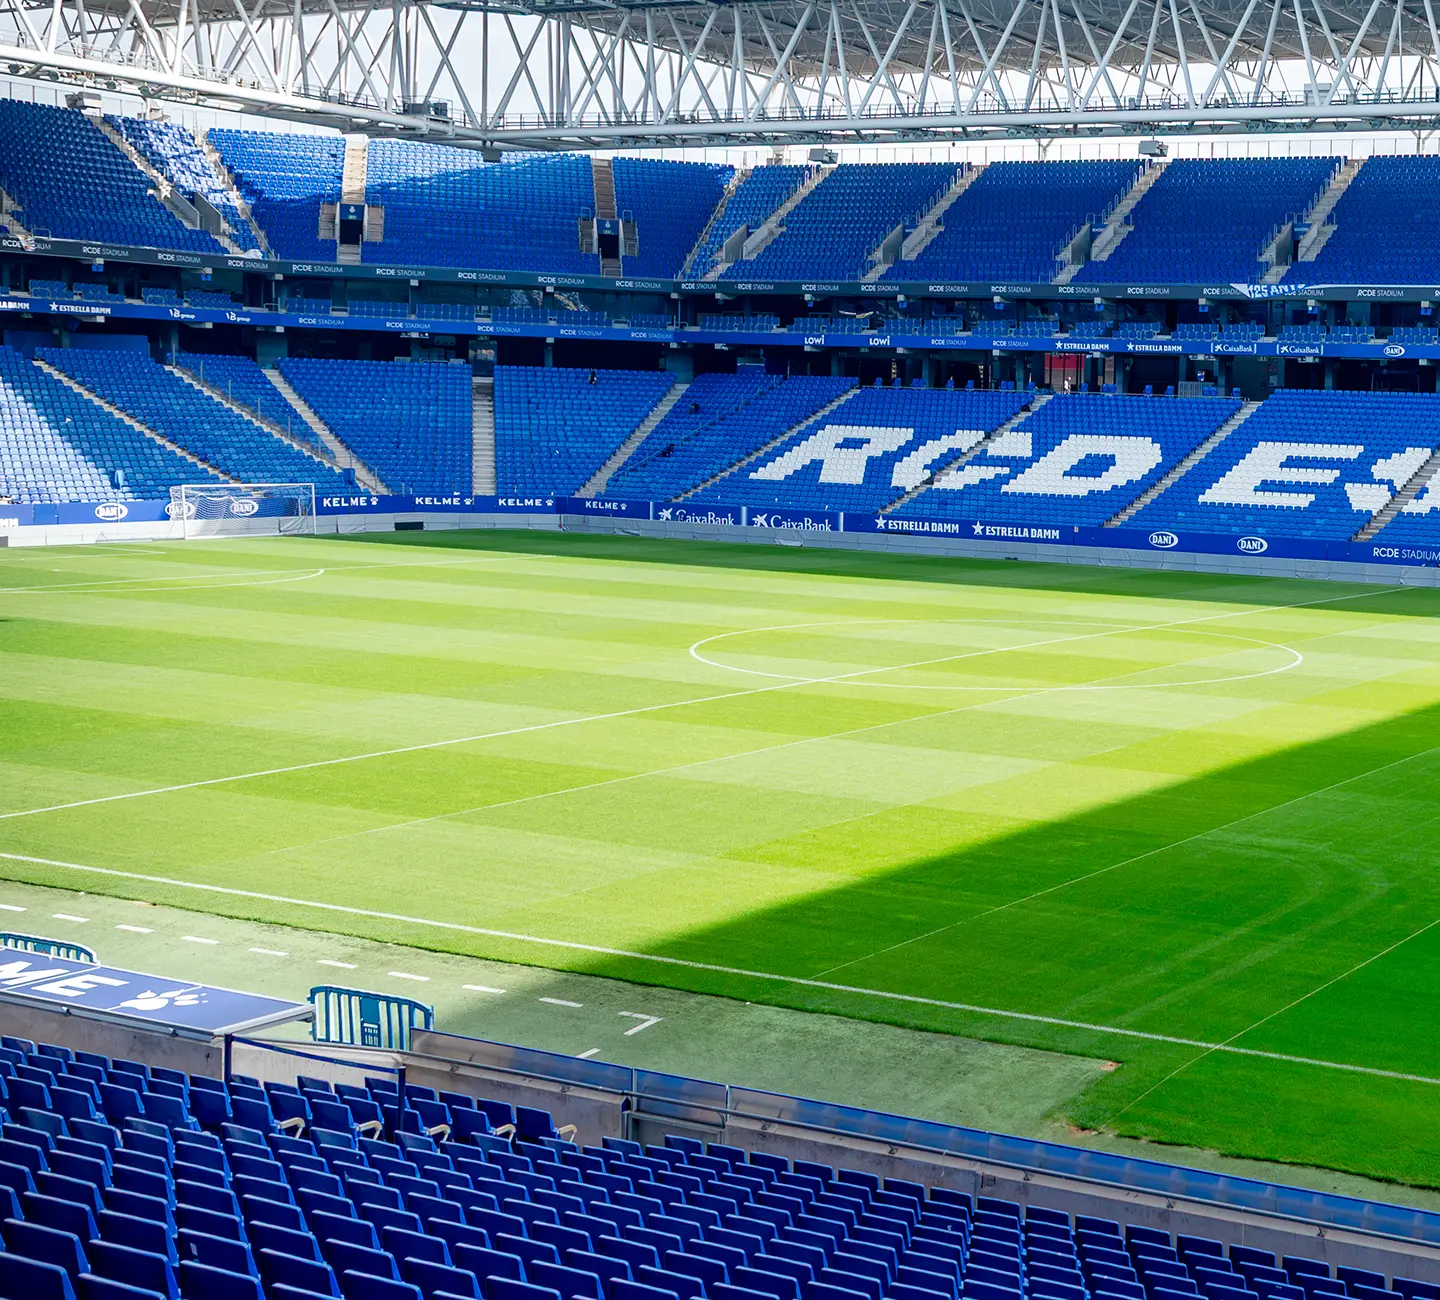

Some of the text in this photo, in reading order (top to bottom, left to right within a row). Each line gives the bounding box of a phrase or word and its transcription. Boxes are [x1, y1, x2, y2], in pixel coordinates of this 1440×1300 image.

[102, 248, 129, 256] STADIUM
[158, 253, 201, 263] RCDE STADIUM
[245, 259, 268, 268] STADIUM
[293, 264, 311, 272] RCDE
[395, 268, 425, 276] STADIUM
[538, 277, 555, 285] RCDE
[1135, 344, 1162, 352] ESTRELLA
[1222, 344, 1252, 352] CaixaBank
[750, 425, 1162, 497] RCD
[323, 497, 367, 507] KELME
[416, 497, 460, 505] KELME
[586, 501, 618, 509] KELME
[676, 509, 735, 526] CaixaBank
[770, 515, 832, 531] CaixaBank
[889, 520, 959, 533] ESTRELLA DAMM
[986, 526, 1059, 539] ESTRELLA DAMM
[1373, 548, 1440, 560] RCDE STADIUM
